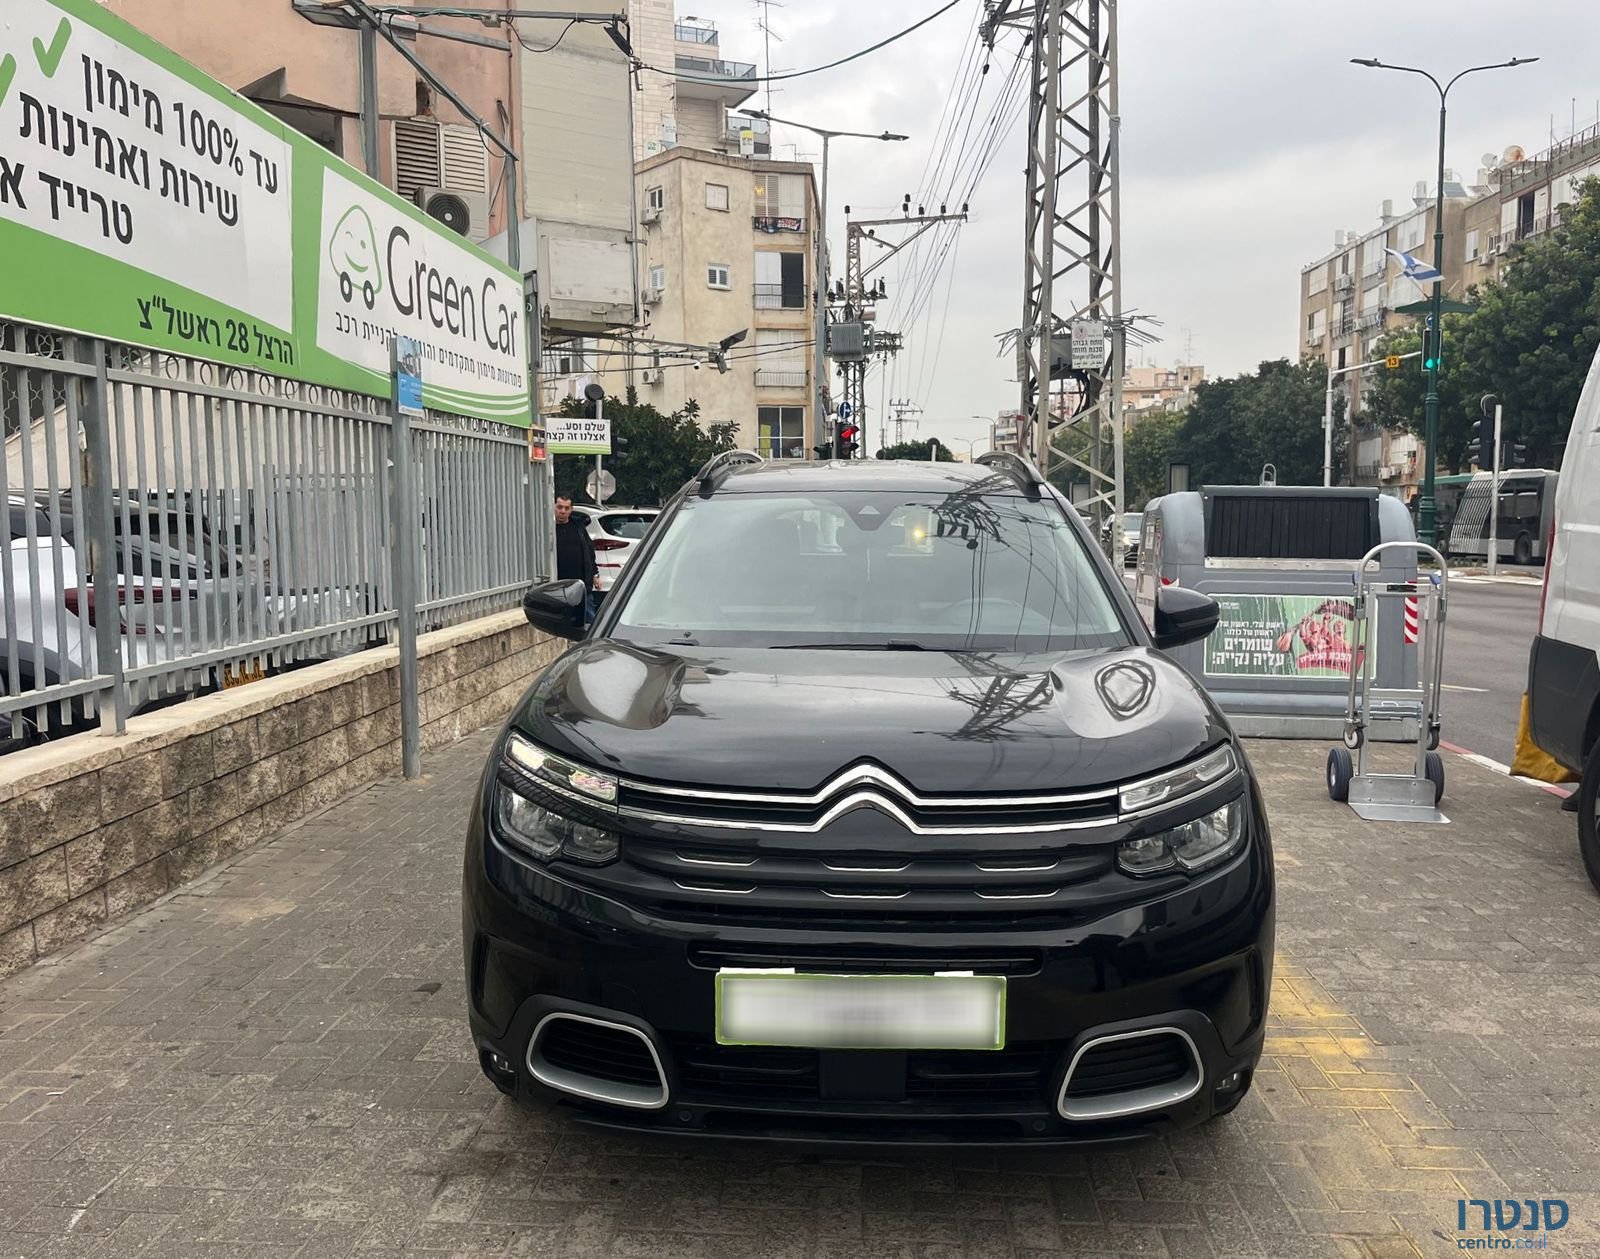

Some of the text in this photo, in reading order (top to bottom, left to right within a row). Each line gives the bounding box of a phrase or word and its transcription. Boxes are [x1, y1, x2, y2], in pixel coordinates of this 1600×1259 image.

[82, 53, 278, 194] עד 100% מימון
[19, 91, 238, 227] שירות ואמינות
[38, 171, 133, 245] טרייד
[387, 225, 518, 357] Green Car
[335, 311, 358, 337] רכב
[226, 319, 249, 354] 28
[253, 325, 293, 366] הרצל
[439, 347, 475, 374] מתקדמים
[477, 361, 496, 380] מימון
[1387, 357, 1397, 366] 13
[497, 368, 522, 388] פתרונות
[567, 432, 578, 441] זה
[580, 432, 606, 441] אצלנו
[584, 421, 605, 431] שלם
[1224, 638, 1273, 651] שומרים
[1212, 651, 1285, 667] עליה נקייה!
